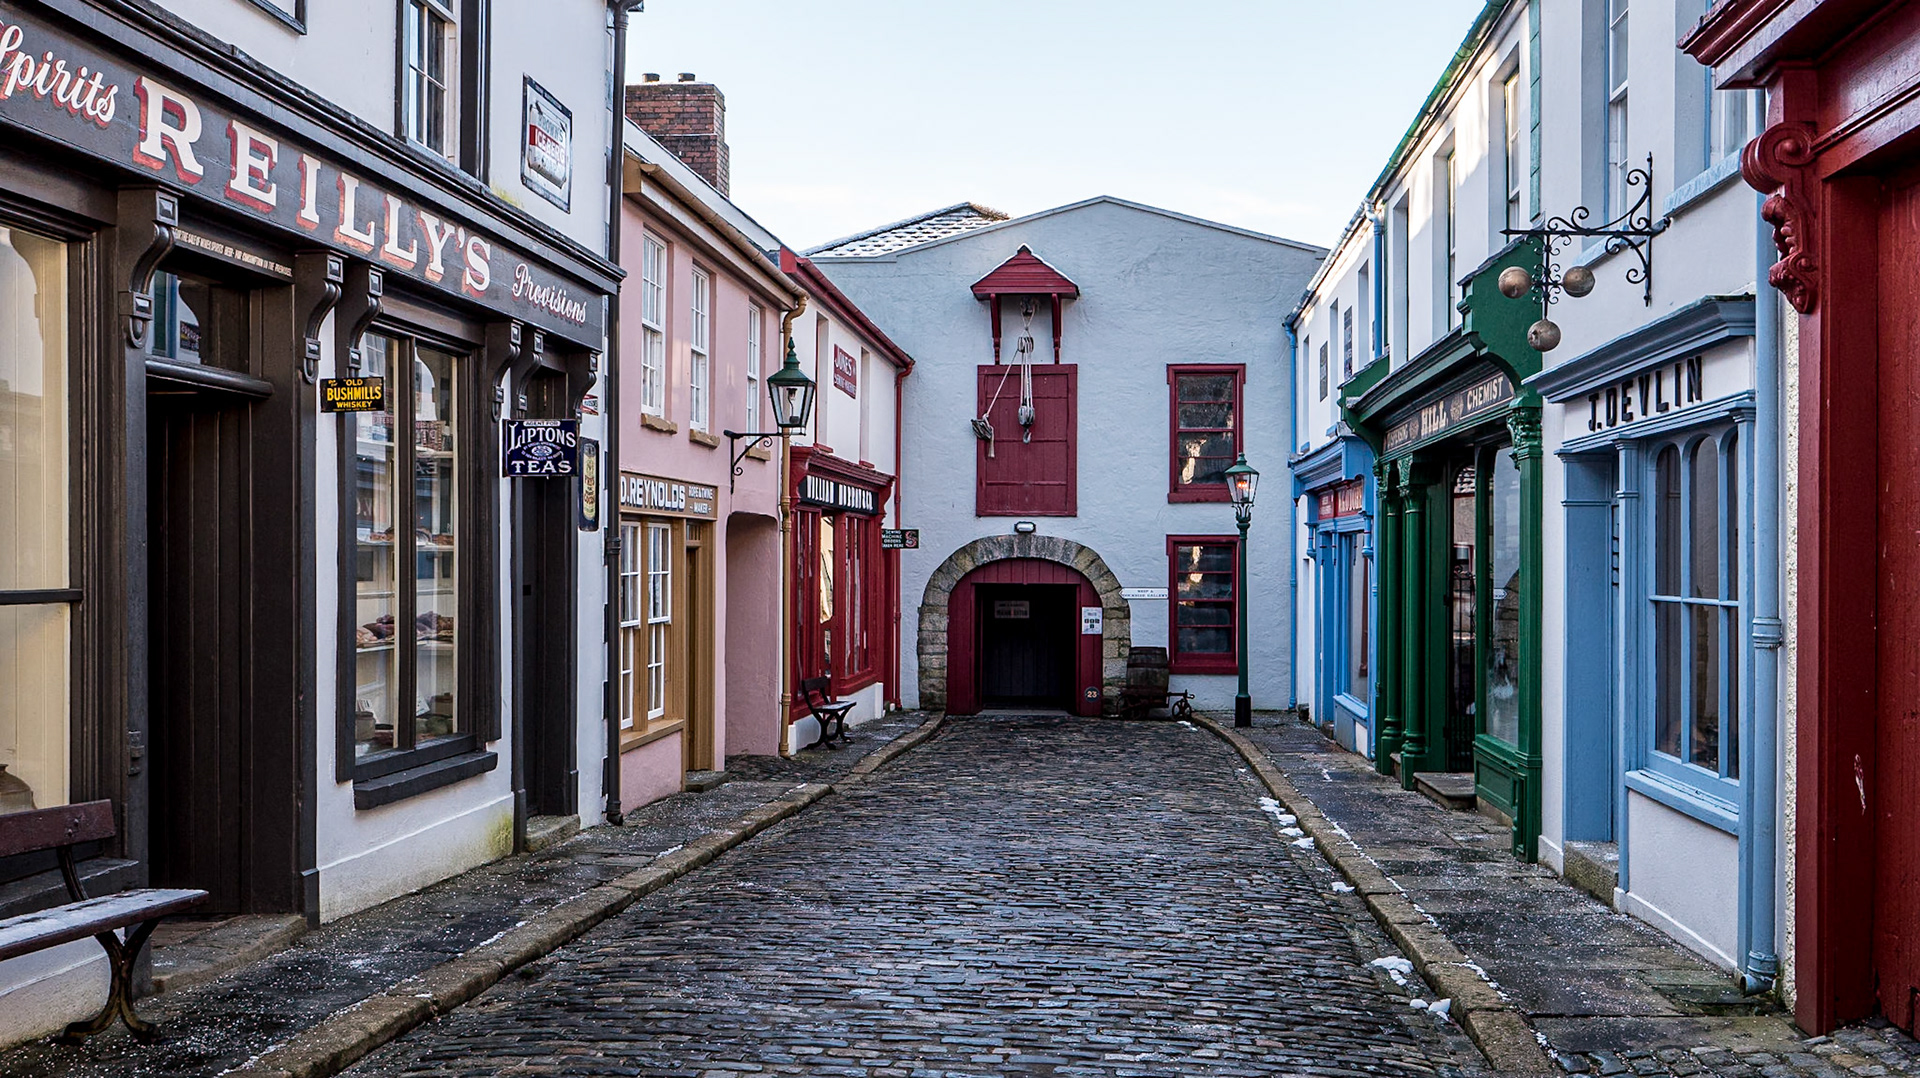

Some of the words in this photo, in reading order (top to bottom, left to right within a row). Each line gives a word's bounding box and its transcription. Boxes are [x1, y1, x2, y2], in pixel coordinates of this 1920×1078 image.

[133, 75, 492, 297] REILLY'S
[512, 263, 587, 324] Provisions
[327, 386, 382, 401] BUSHMILLS
[1467, 376, 1504, 411] CHEMIST
[507, 422, 576, 455] LIPTONS
[511, 460, 572, 473] TEAS
[620, 476, 685, 511] D.REYNOLDS
[1087, 690, 1098, 698] 23
